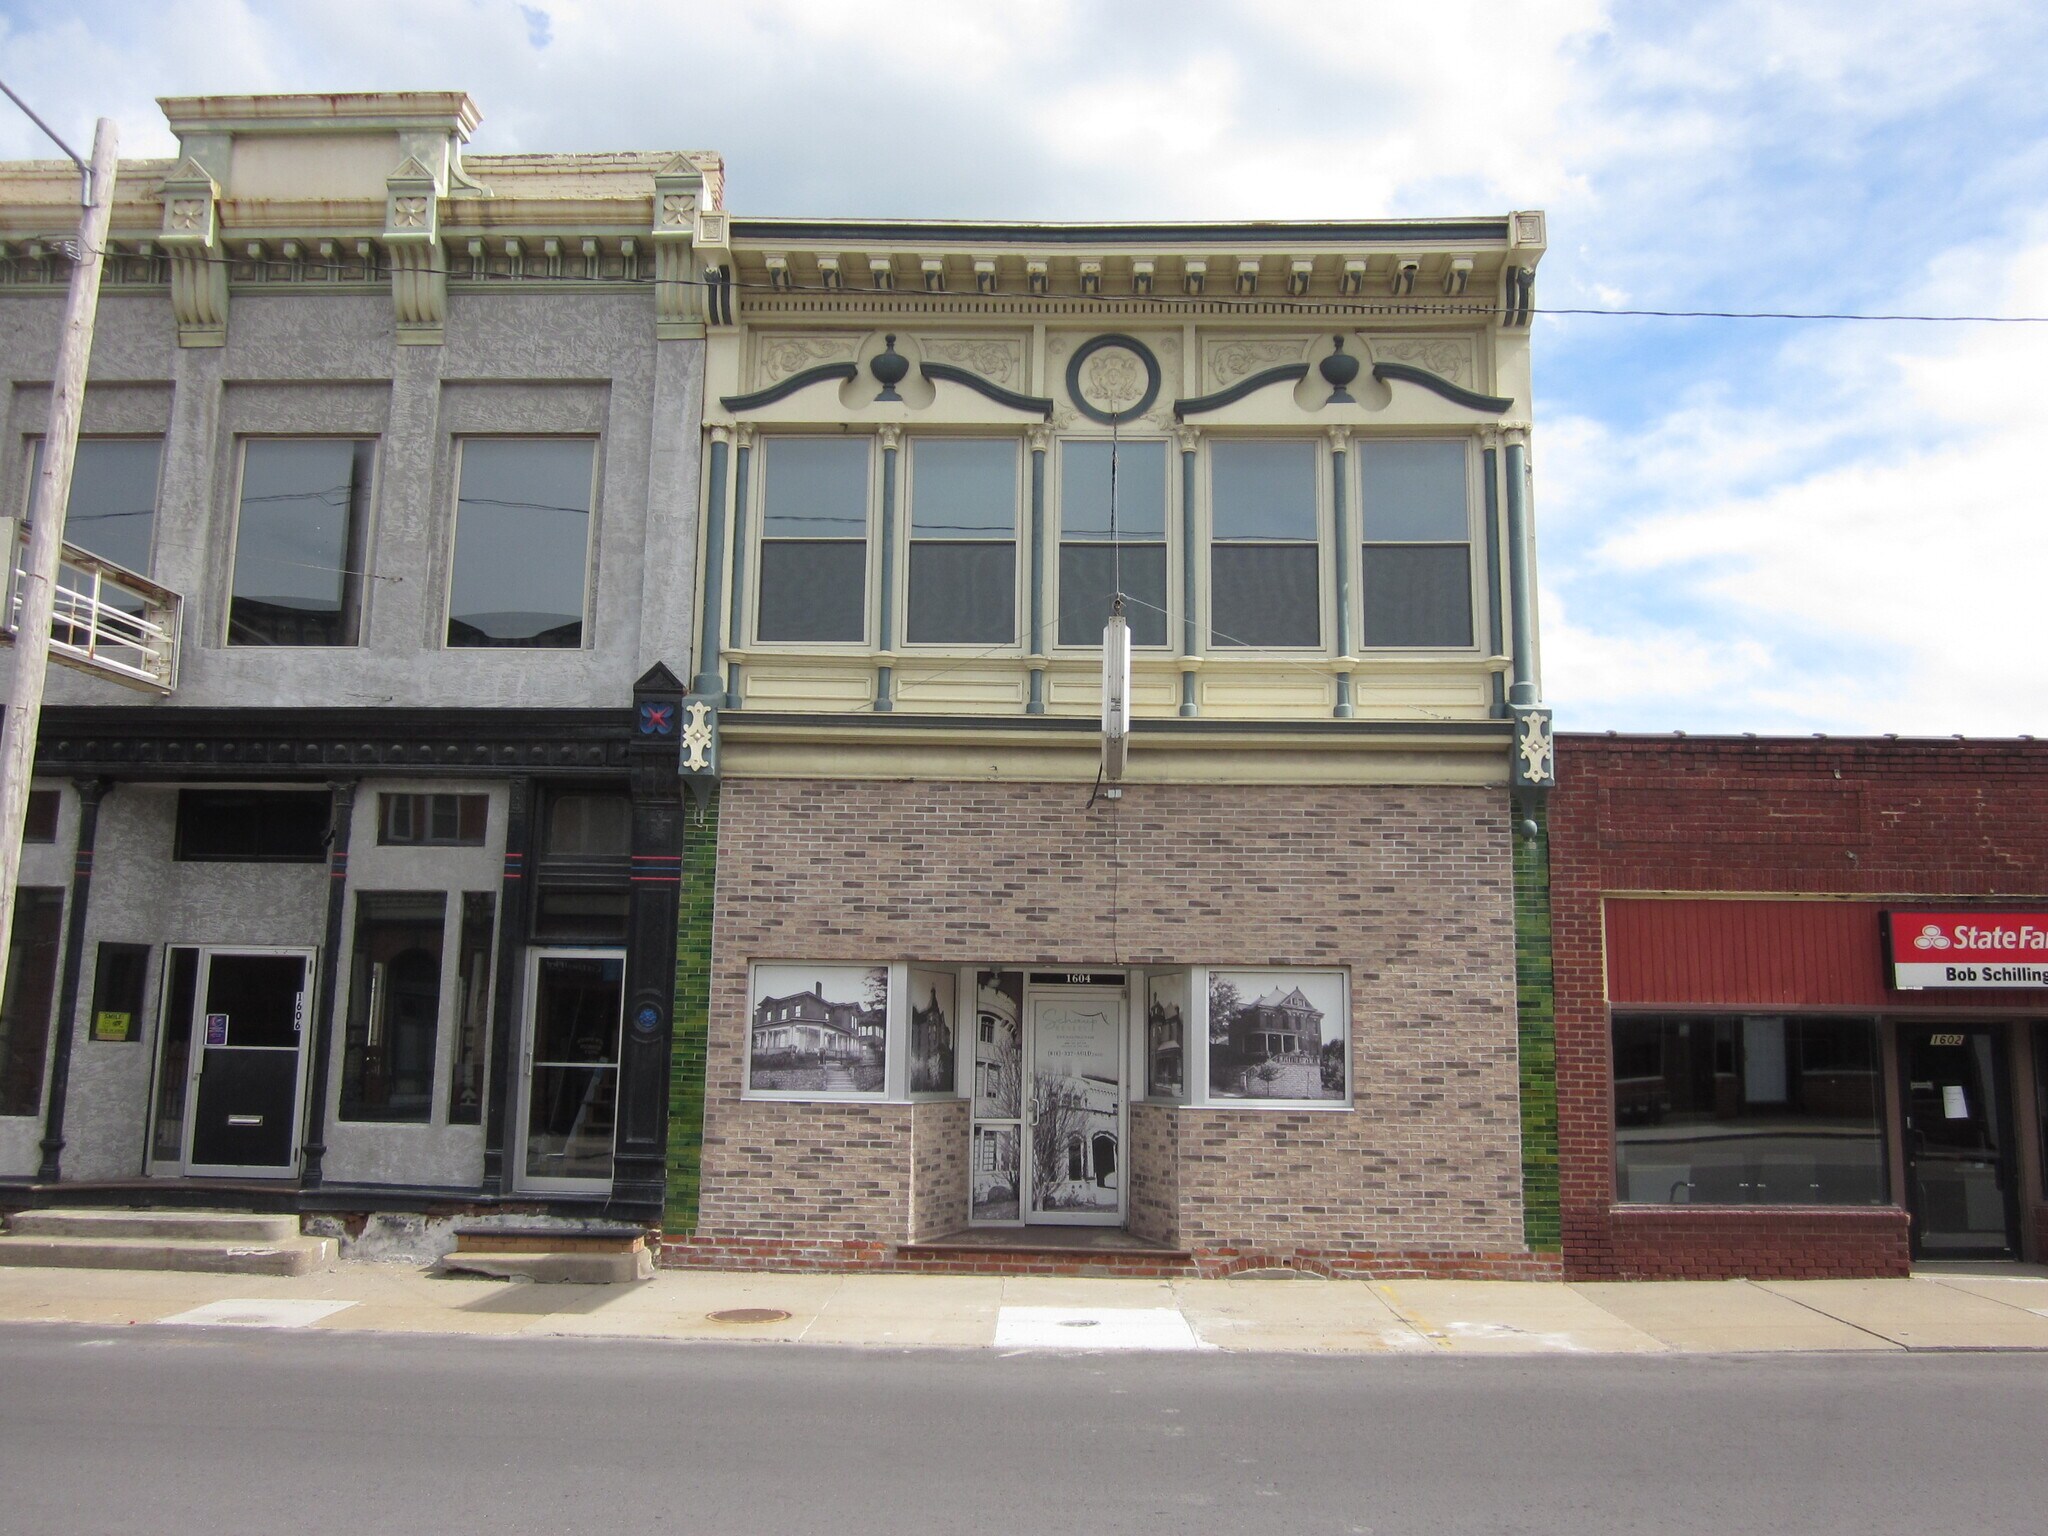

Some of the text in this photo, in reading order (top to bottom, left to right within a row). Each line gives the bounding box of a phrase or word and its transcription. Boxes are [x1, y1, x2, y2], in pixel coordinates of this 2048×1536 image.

[1953, 925, 2017, 949] State
[1066, 974, 1091, 983] 1604
[1946, 967, 1977, 981] Bob
[294, 992, 303, 1030] 1606
[1933, 1035, 1963, 1045] 1602
